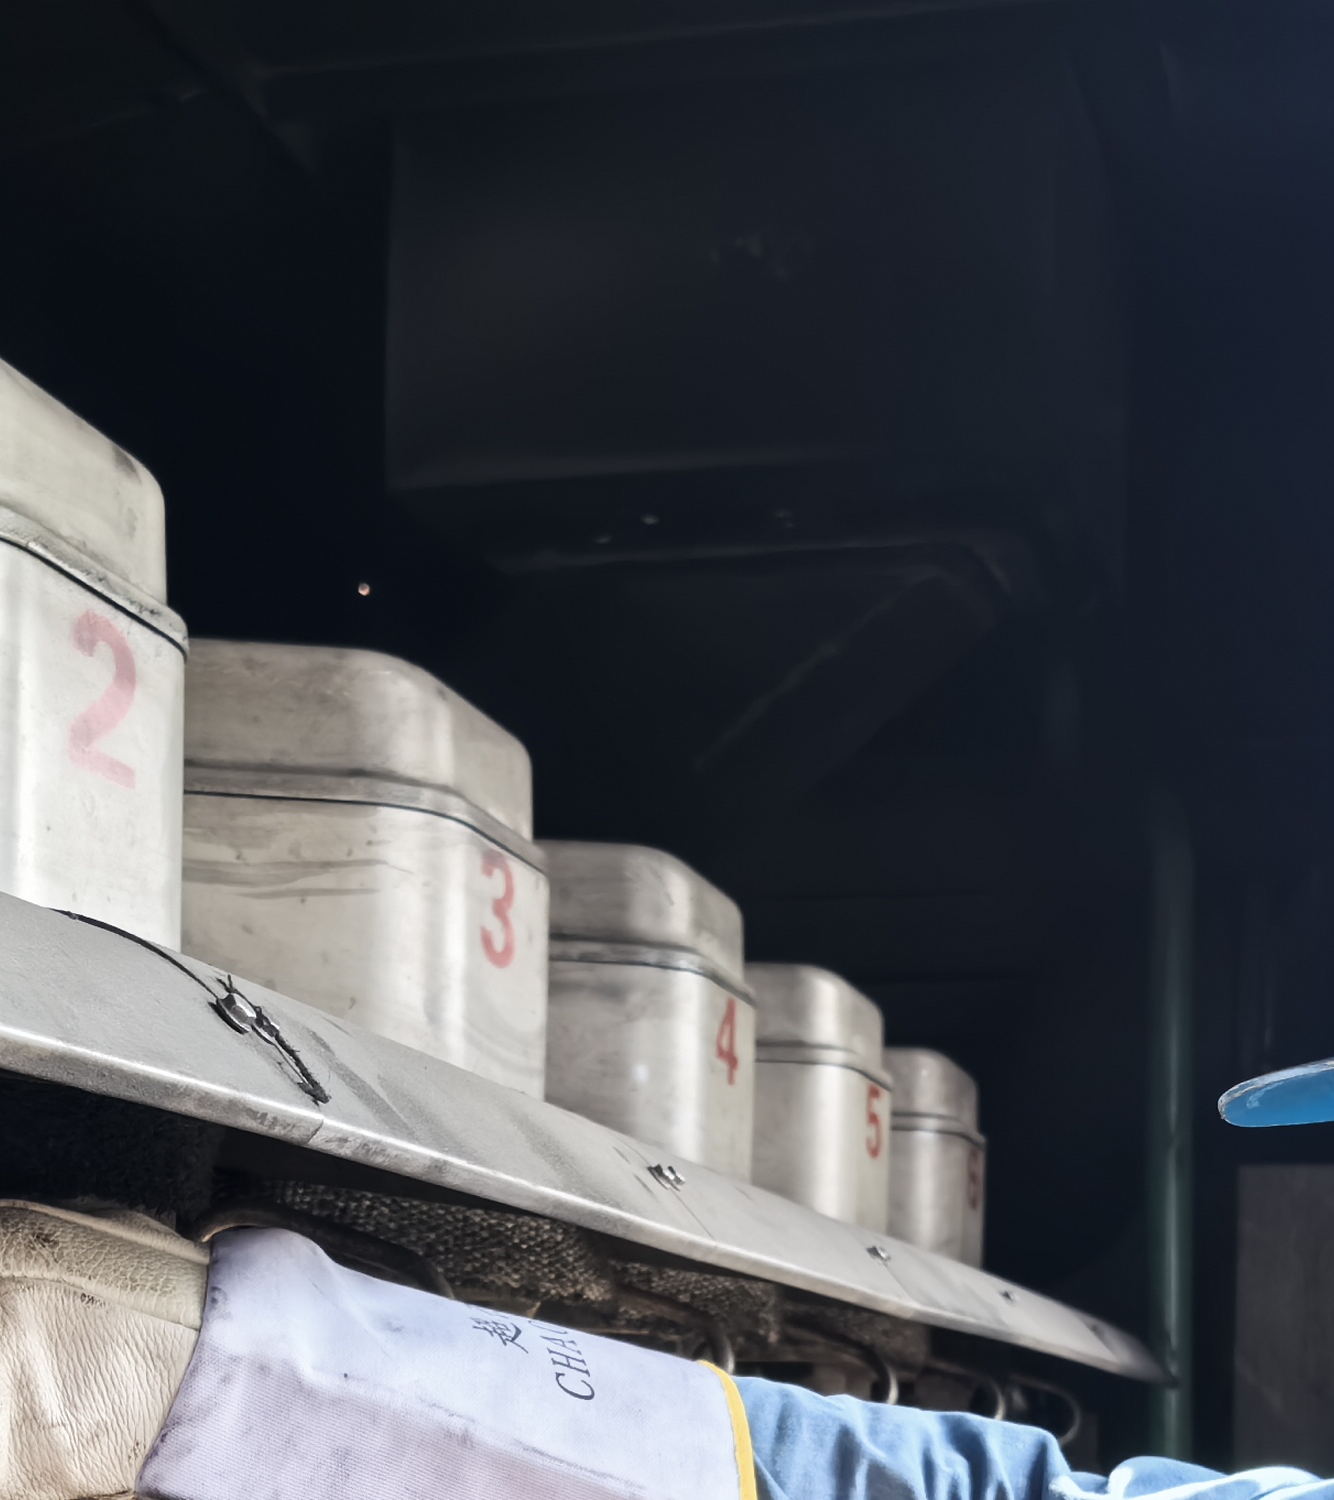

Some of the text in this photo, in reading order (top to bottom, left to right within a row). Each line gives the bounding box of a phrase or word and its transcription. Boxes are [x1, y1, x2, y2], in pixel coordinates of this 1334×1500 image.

[68, 609, 138, 782] 2
[480, 849, 515, 969] 3
[715, 997, 739, 1086] 4
[866, 1083, 883, 1160] 5
